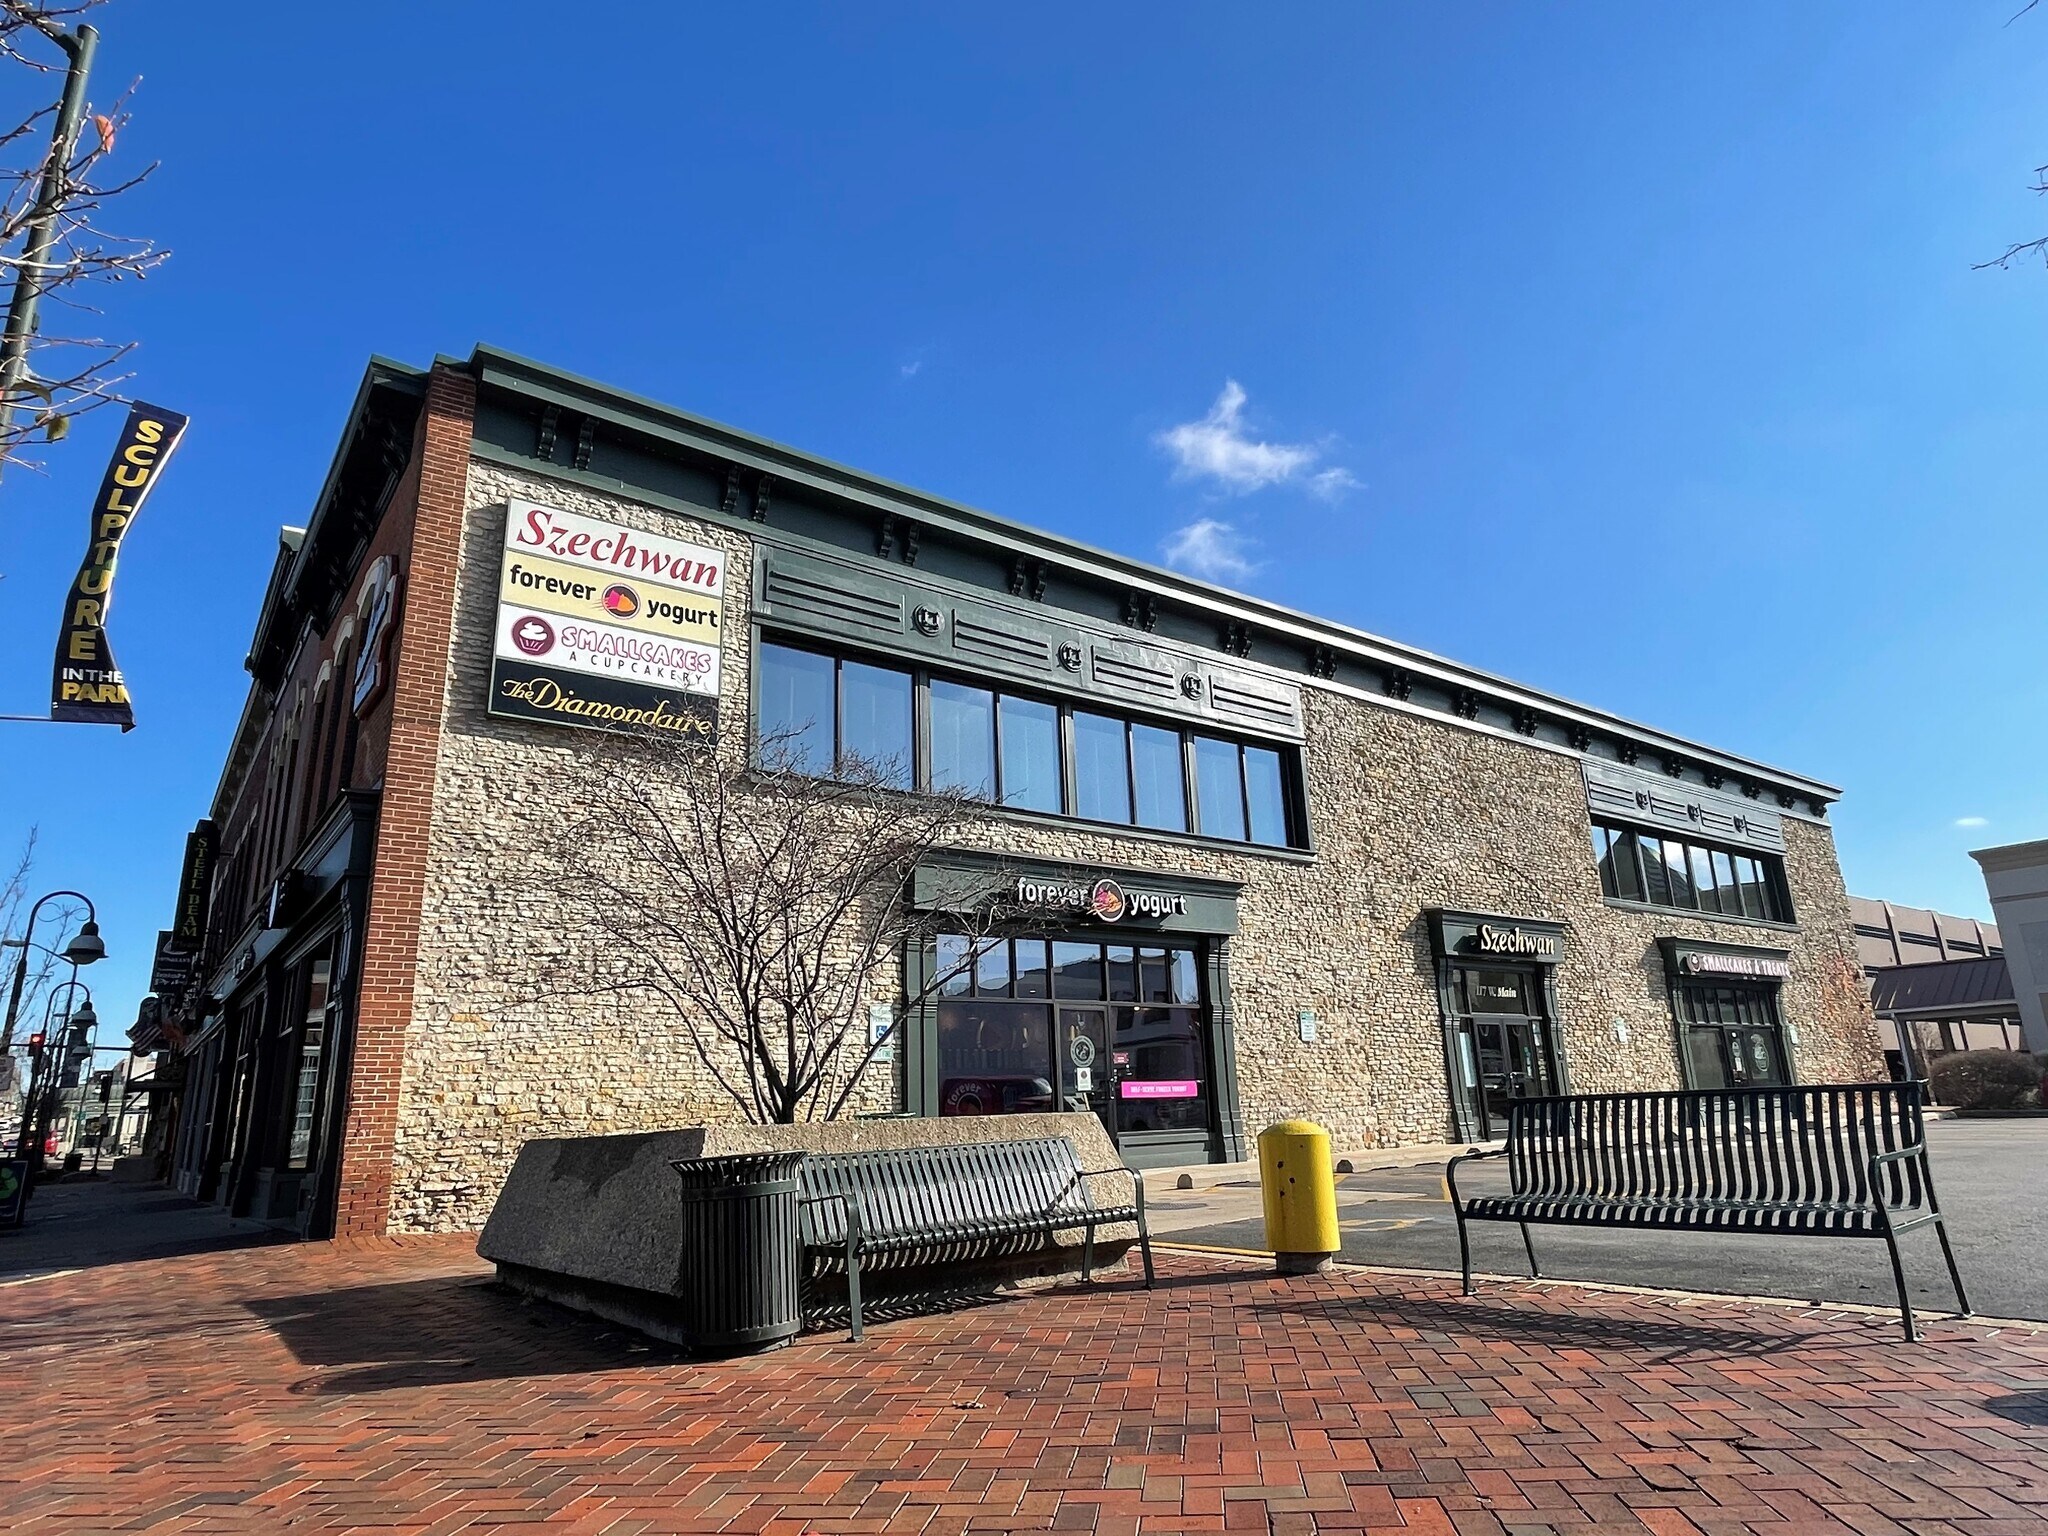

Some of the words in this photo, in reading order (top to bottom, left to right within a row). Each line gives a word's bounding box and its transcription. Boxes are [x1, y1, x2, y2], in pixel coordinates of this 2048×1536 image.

[68, 419, 164, 661] SCULPTURE
[516, 509, 718, 587] Szechwan
[509, 564, 596, 600] forever
[646, 599, 718, 628] yogurt
[561, 626, 711, 673] SMALLCAKES
[569, 651, 577, 661] A
[590, 655, 702, 682] CUPCAKERY
[62, 667, 88, 682] IN
[501, 679, 534, 701] The
[526, 677, 711, 735] Diamondaire
[190, 837, 208, 889] STEEL
[180, 893, 200, 937] BEAM
[1017, 876, 1088, 906] forever
[1129, 893, 1188, 918] yogurt
[1481, 924, 1555, 955] Szechwan
[1702, 955, 1753, 975] SMALLCAKES
[1761, 959, 1793, 979] TREATS
[1497, 986, 1517, 998] Main
[947, 1083, 982, 1106] forever
